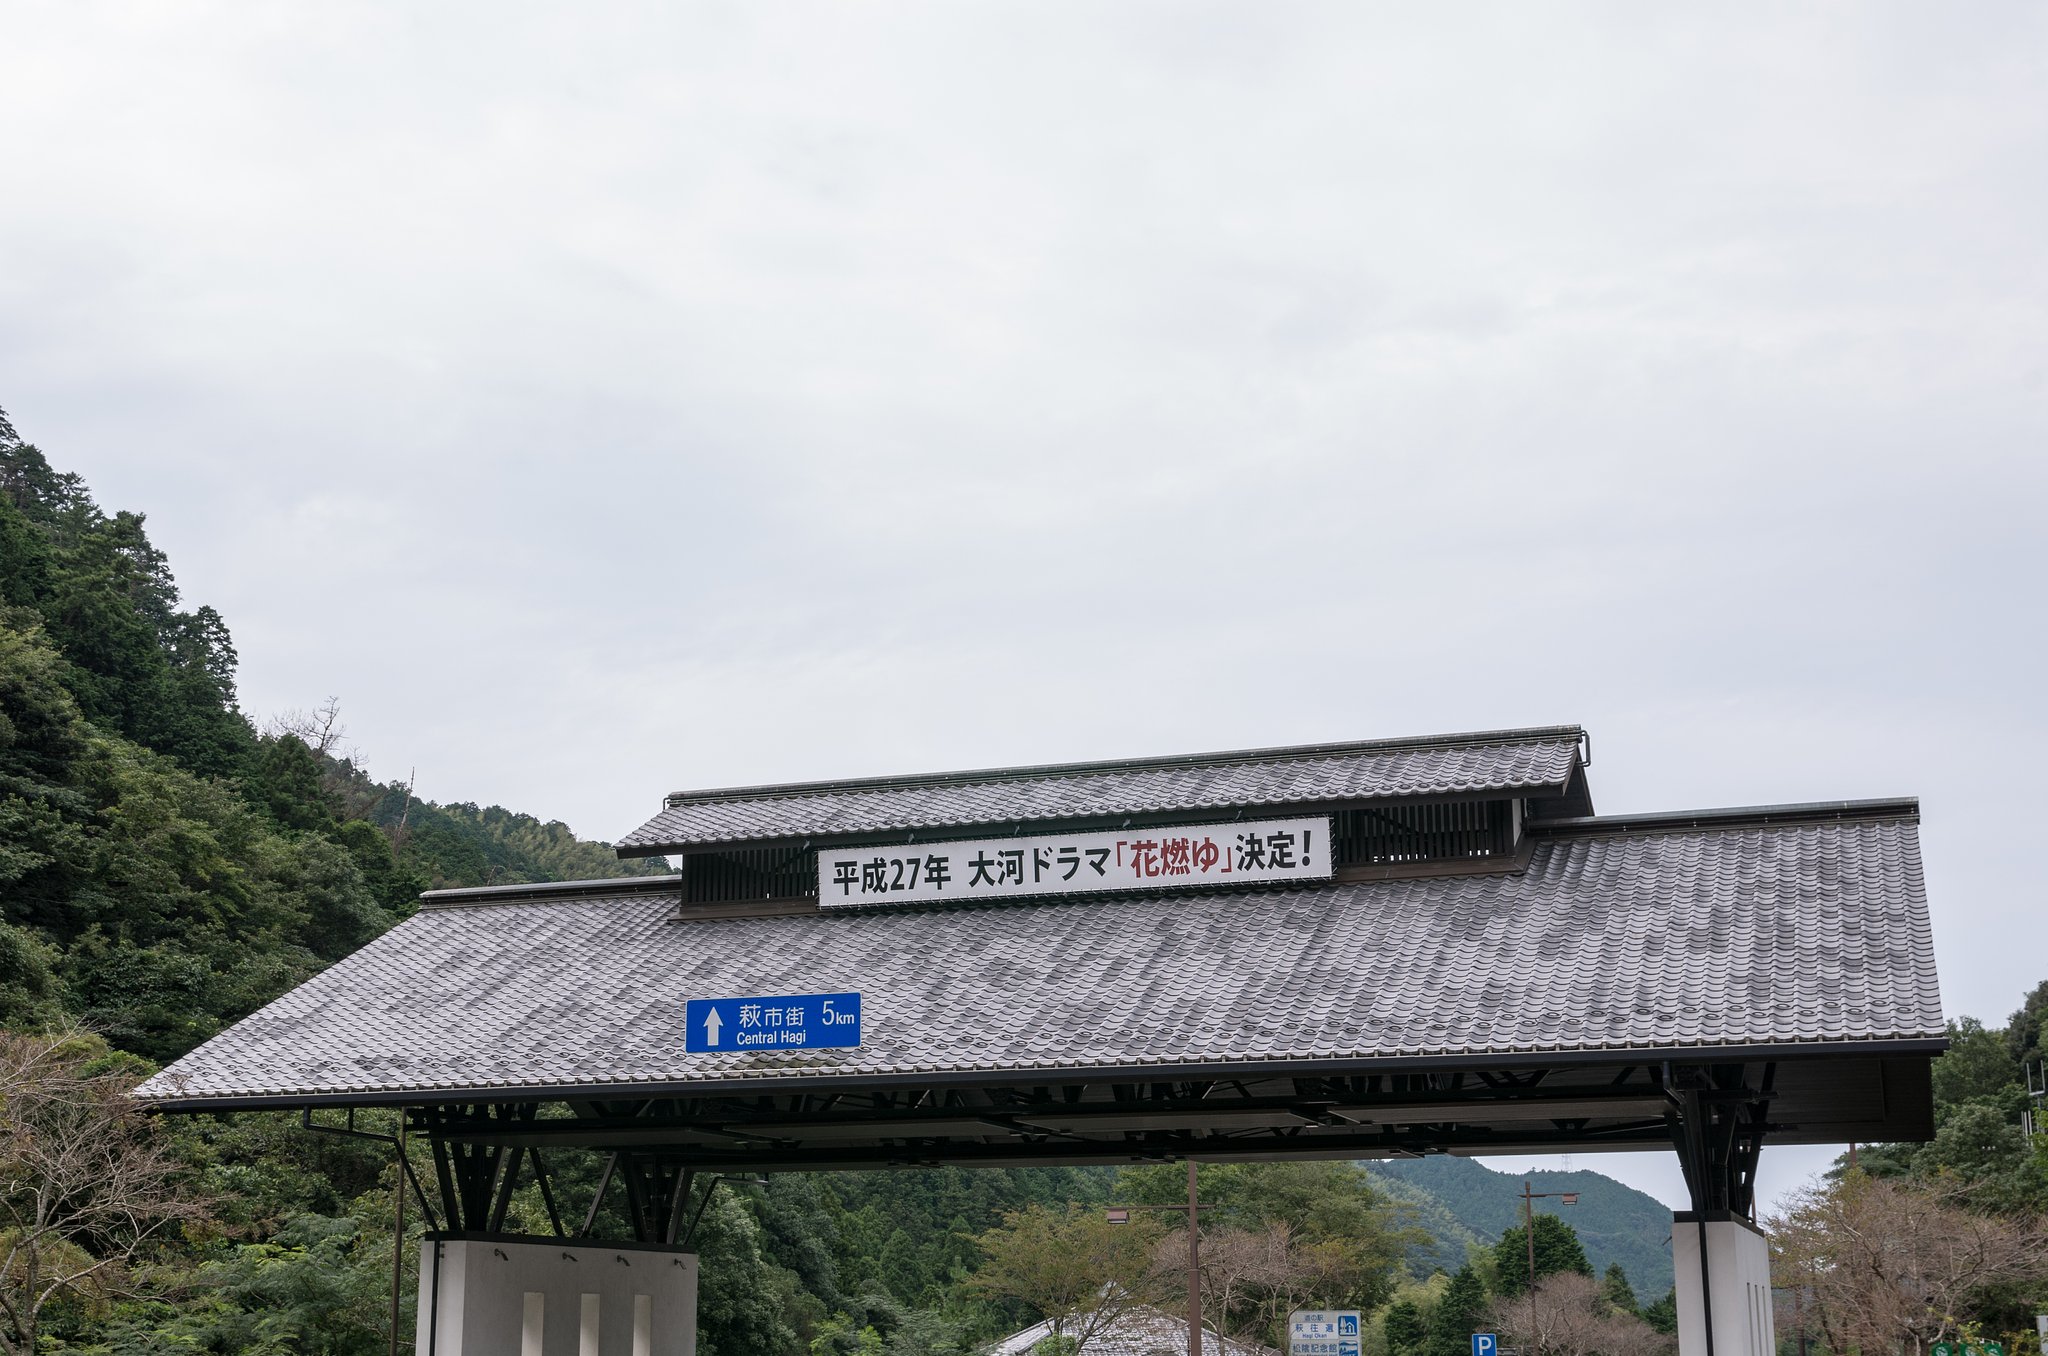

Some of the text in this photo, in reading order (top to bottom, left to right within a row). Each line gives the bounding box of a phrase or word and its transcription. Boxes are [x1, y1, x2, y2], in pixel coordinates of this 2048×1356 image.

[833, 854, 951, 895] 平成27年
[739, 1004, 804, 1028] 萩市街
[822, 1000, 855, 1026] 5km
[737, 1030, 806, 1045] Central Hagi
[1478, 1336, 1492, 1356] P
